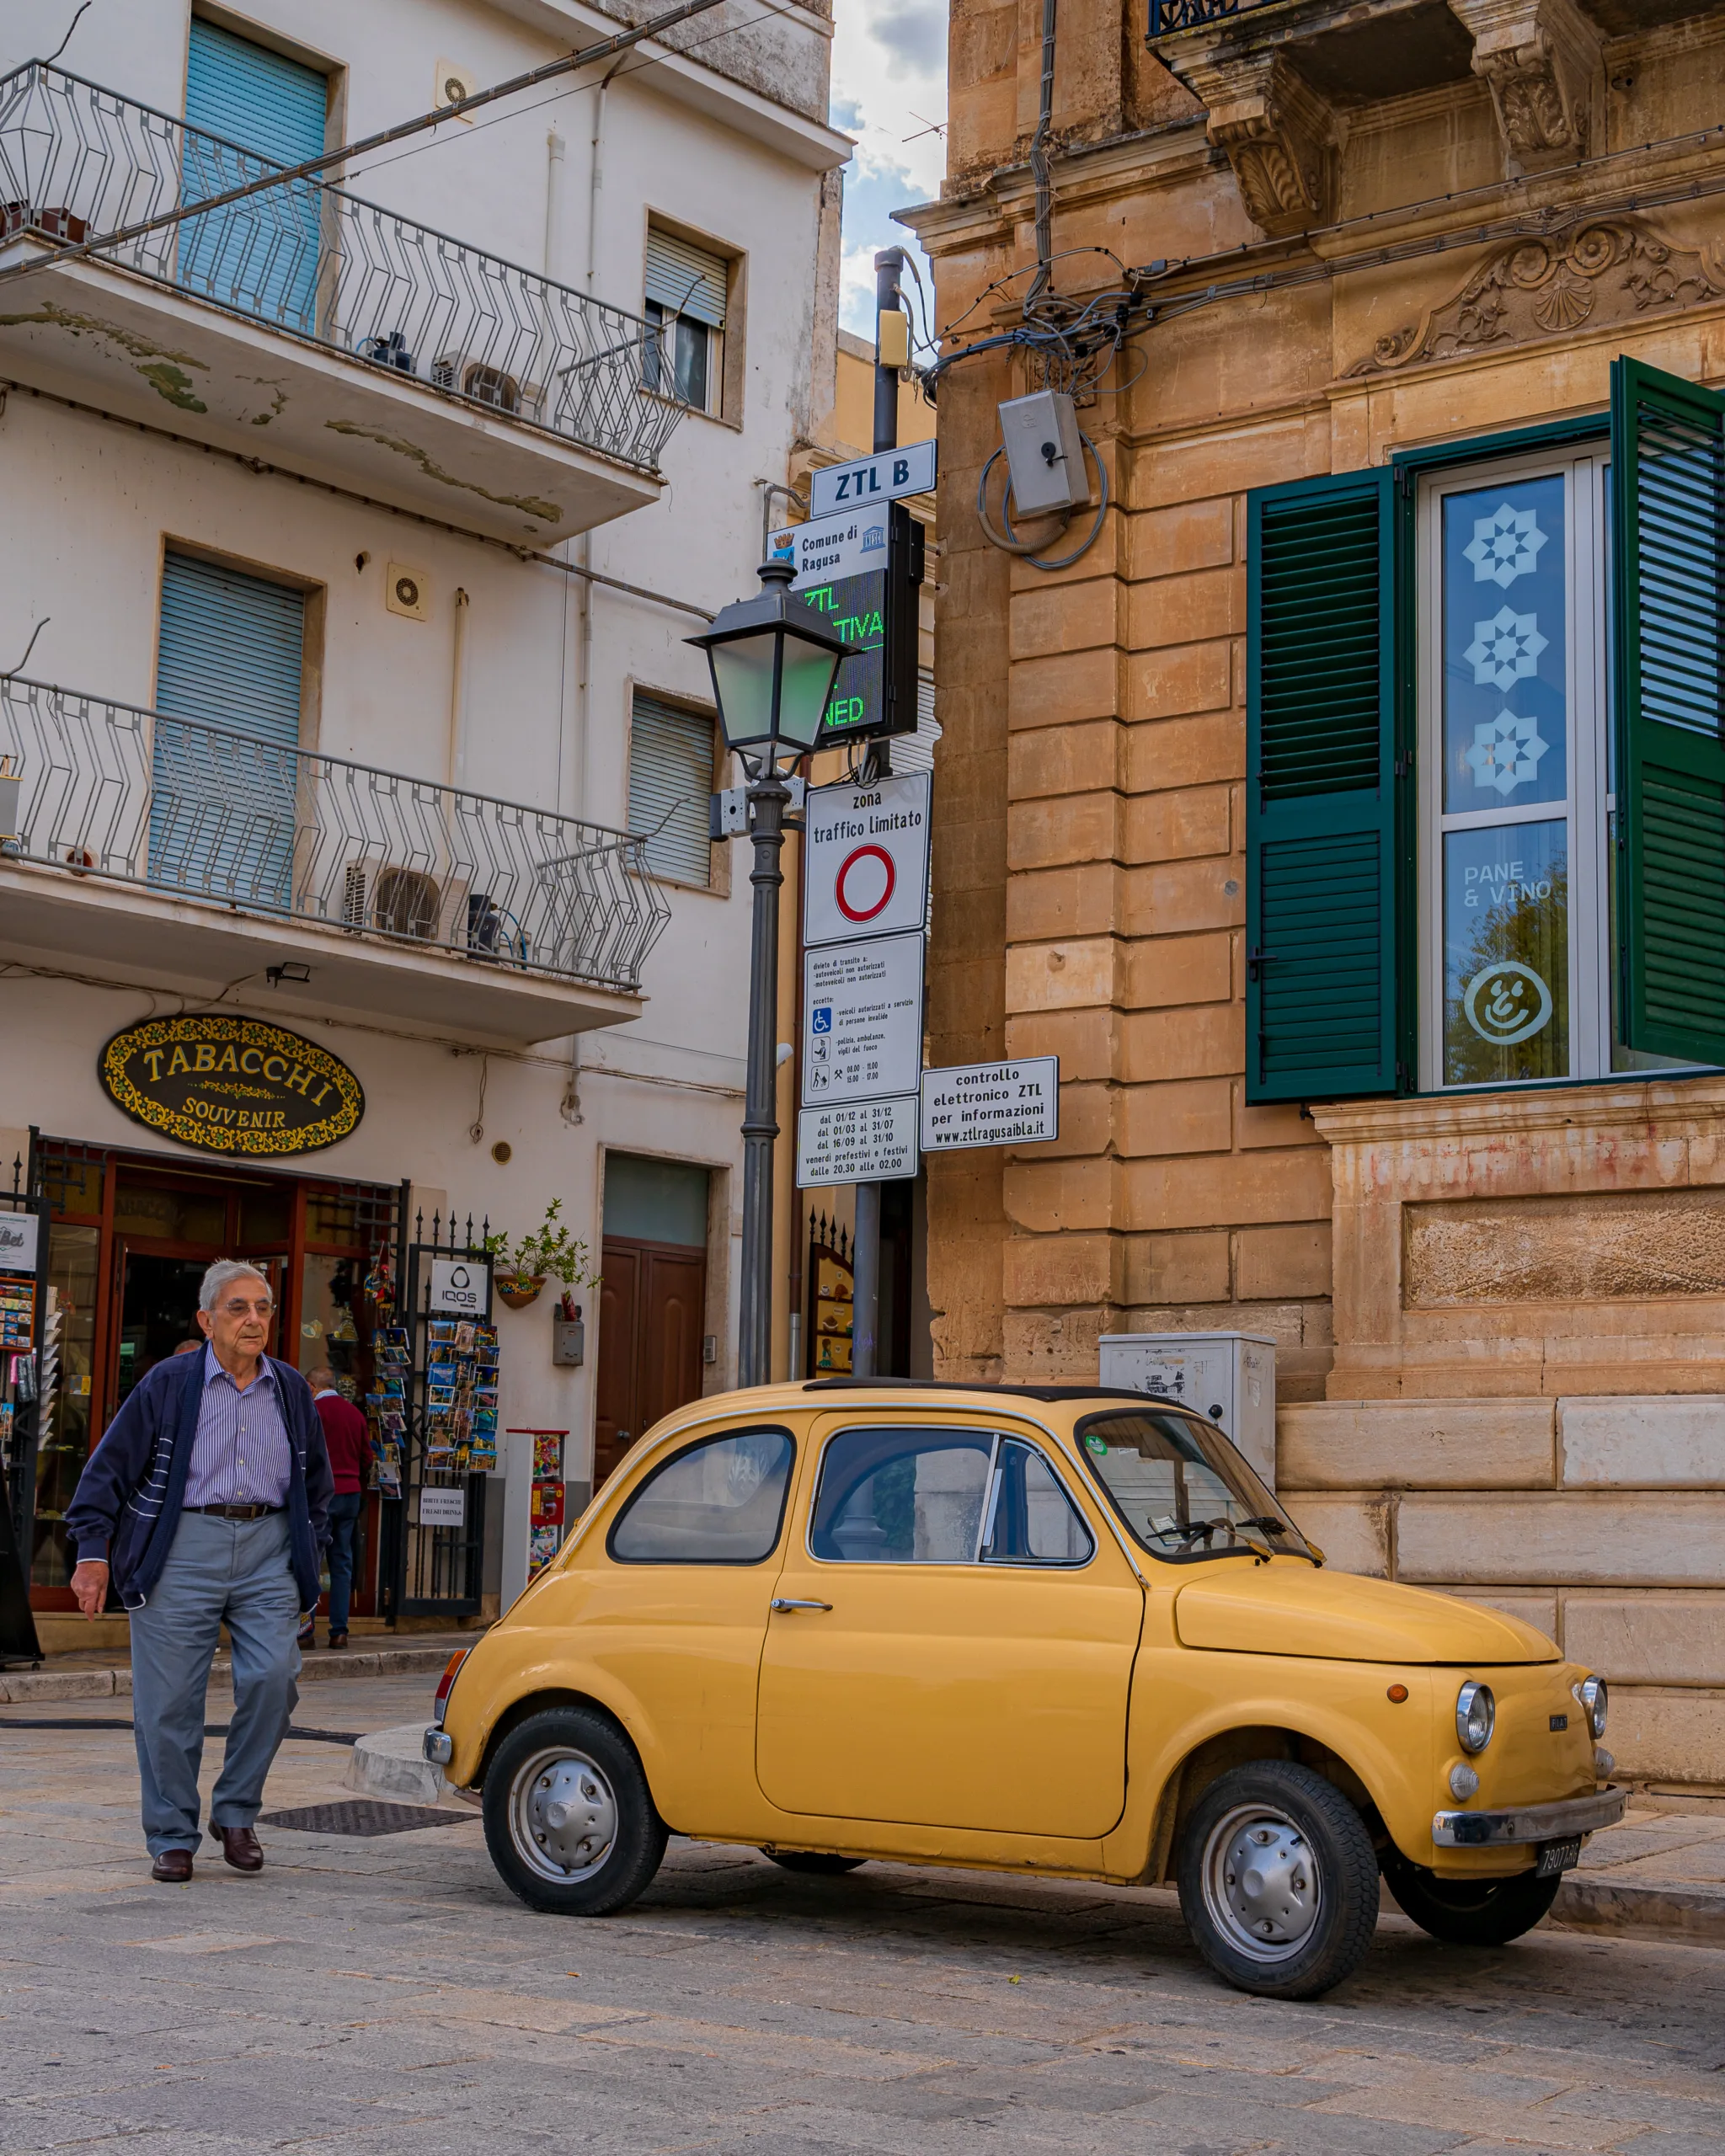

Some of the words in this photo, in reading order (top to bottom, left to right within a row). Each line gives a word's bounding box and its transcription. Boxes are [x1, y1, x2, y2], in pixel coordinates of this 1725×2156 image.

[836, 467, 881, 501] ZTL
[893, 459, 909, 487] B
[802, 532, 845, 552] Comune
[847, 525, 857, 541] di
[862, 531, 884, 548] UNESCO
[802, 553, 841, 573] Ragusa
[833, 611, 884, 643] TIVA
[853, 792, 882, 809] zona
[814, 820, 865, 844] traffico
[869, 810, 921, 835] limitato
[1464, 861, 1525, 885] PANE
[1464, 889, 1479, 908] &
[1490, 880, 1551, 905] VINO
[814, 969, 843, 979] -autoveicoli
[857, 961, 885, 971] autorizzati
[840, 957, 860, 966] transito
[813, 977, 845, 988] -motoveicoli
[859, 970, 886, 981] autorizzati
[813, 996, 834, 1005] eccetto:
[836, 1007, 856, 1016] -veicoli
[858, 1002, 885, 1013] autorizzati
[894, 999, 914, 1008] servizio
[846, 1017, 866, 1026] persone
[868, 1013, 889, 1022] invalide
[837, 1047, 851, 1056] vigili
[852, 1045, 861, 1054] del
[143, 1044, 333, 1107] TABACCHI
[846, 1065, 860, 1073] 08.00
[867, 1061, 879, 1070] 11.00
[846, 1075, 859, 1084] 15.00
[867, 1071, 879, 1081] 17.00
[956, 1068, 1019, 1086] controllo
[933, 1089, 1009, 1107] elettronico
[1018, 1083, 1043, 1098] ZTL
[182, 1097, 286, 1129] SOUVENIR
[820, 1115, 831, 1124] dal
[836, 1112, 856, 1123] 01/12
[860, 1110, 868, 1119] al
[872, 1107, 892, 1118] 31/12
[932, 1114, 953, 1128] per
[961, 1102, 1044, 1123] informazioni
[817, 1128, 829, 1138] dal
[833, 1124, 856, 1135] 01/03
[860, 1123, 868, 1132] al
[872, 1119, 894, 1130] 31/07
[936, 1121, 1044, 1144] www.ztlragusaibla.it
[817, 1140, 829, 1150] dal
[833, 1137, 856, 1148] 16/09
[859, 1135, 868, 1145] al
[873, 1132, 894, 1144] 31/10
[835, 1149, 870, 1163] prefestivi
[883, 1145, 908, 1157] festivi
[810, 1166, 830, 1177] dalle
[833, 1163, 855, 1174] 20.30
[859, 1161, 874, 1171] alle
[879, 1158, 902, 1170] 02.00
[0, 1230, 24, 1247] Bet
[442, 1290, 477, 1303] IQOS
[1551, 1716, 1567, 1729] FIAT
